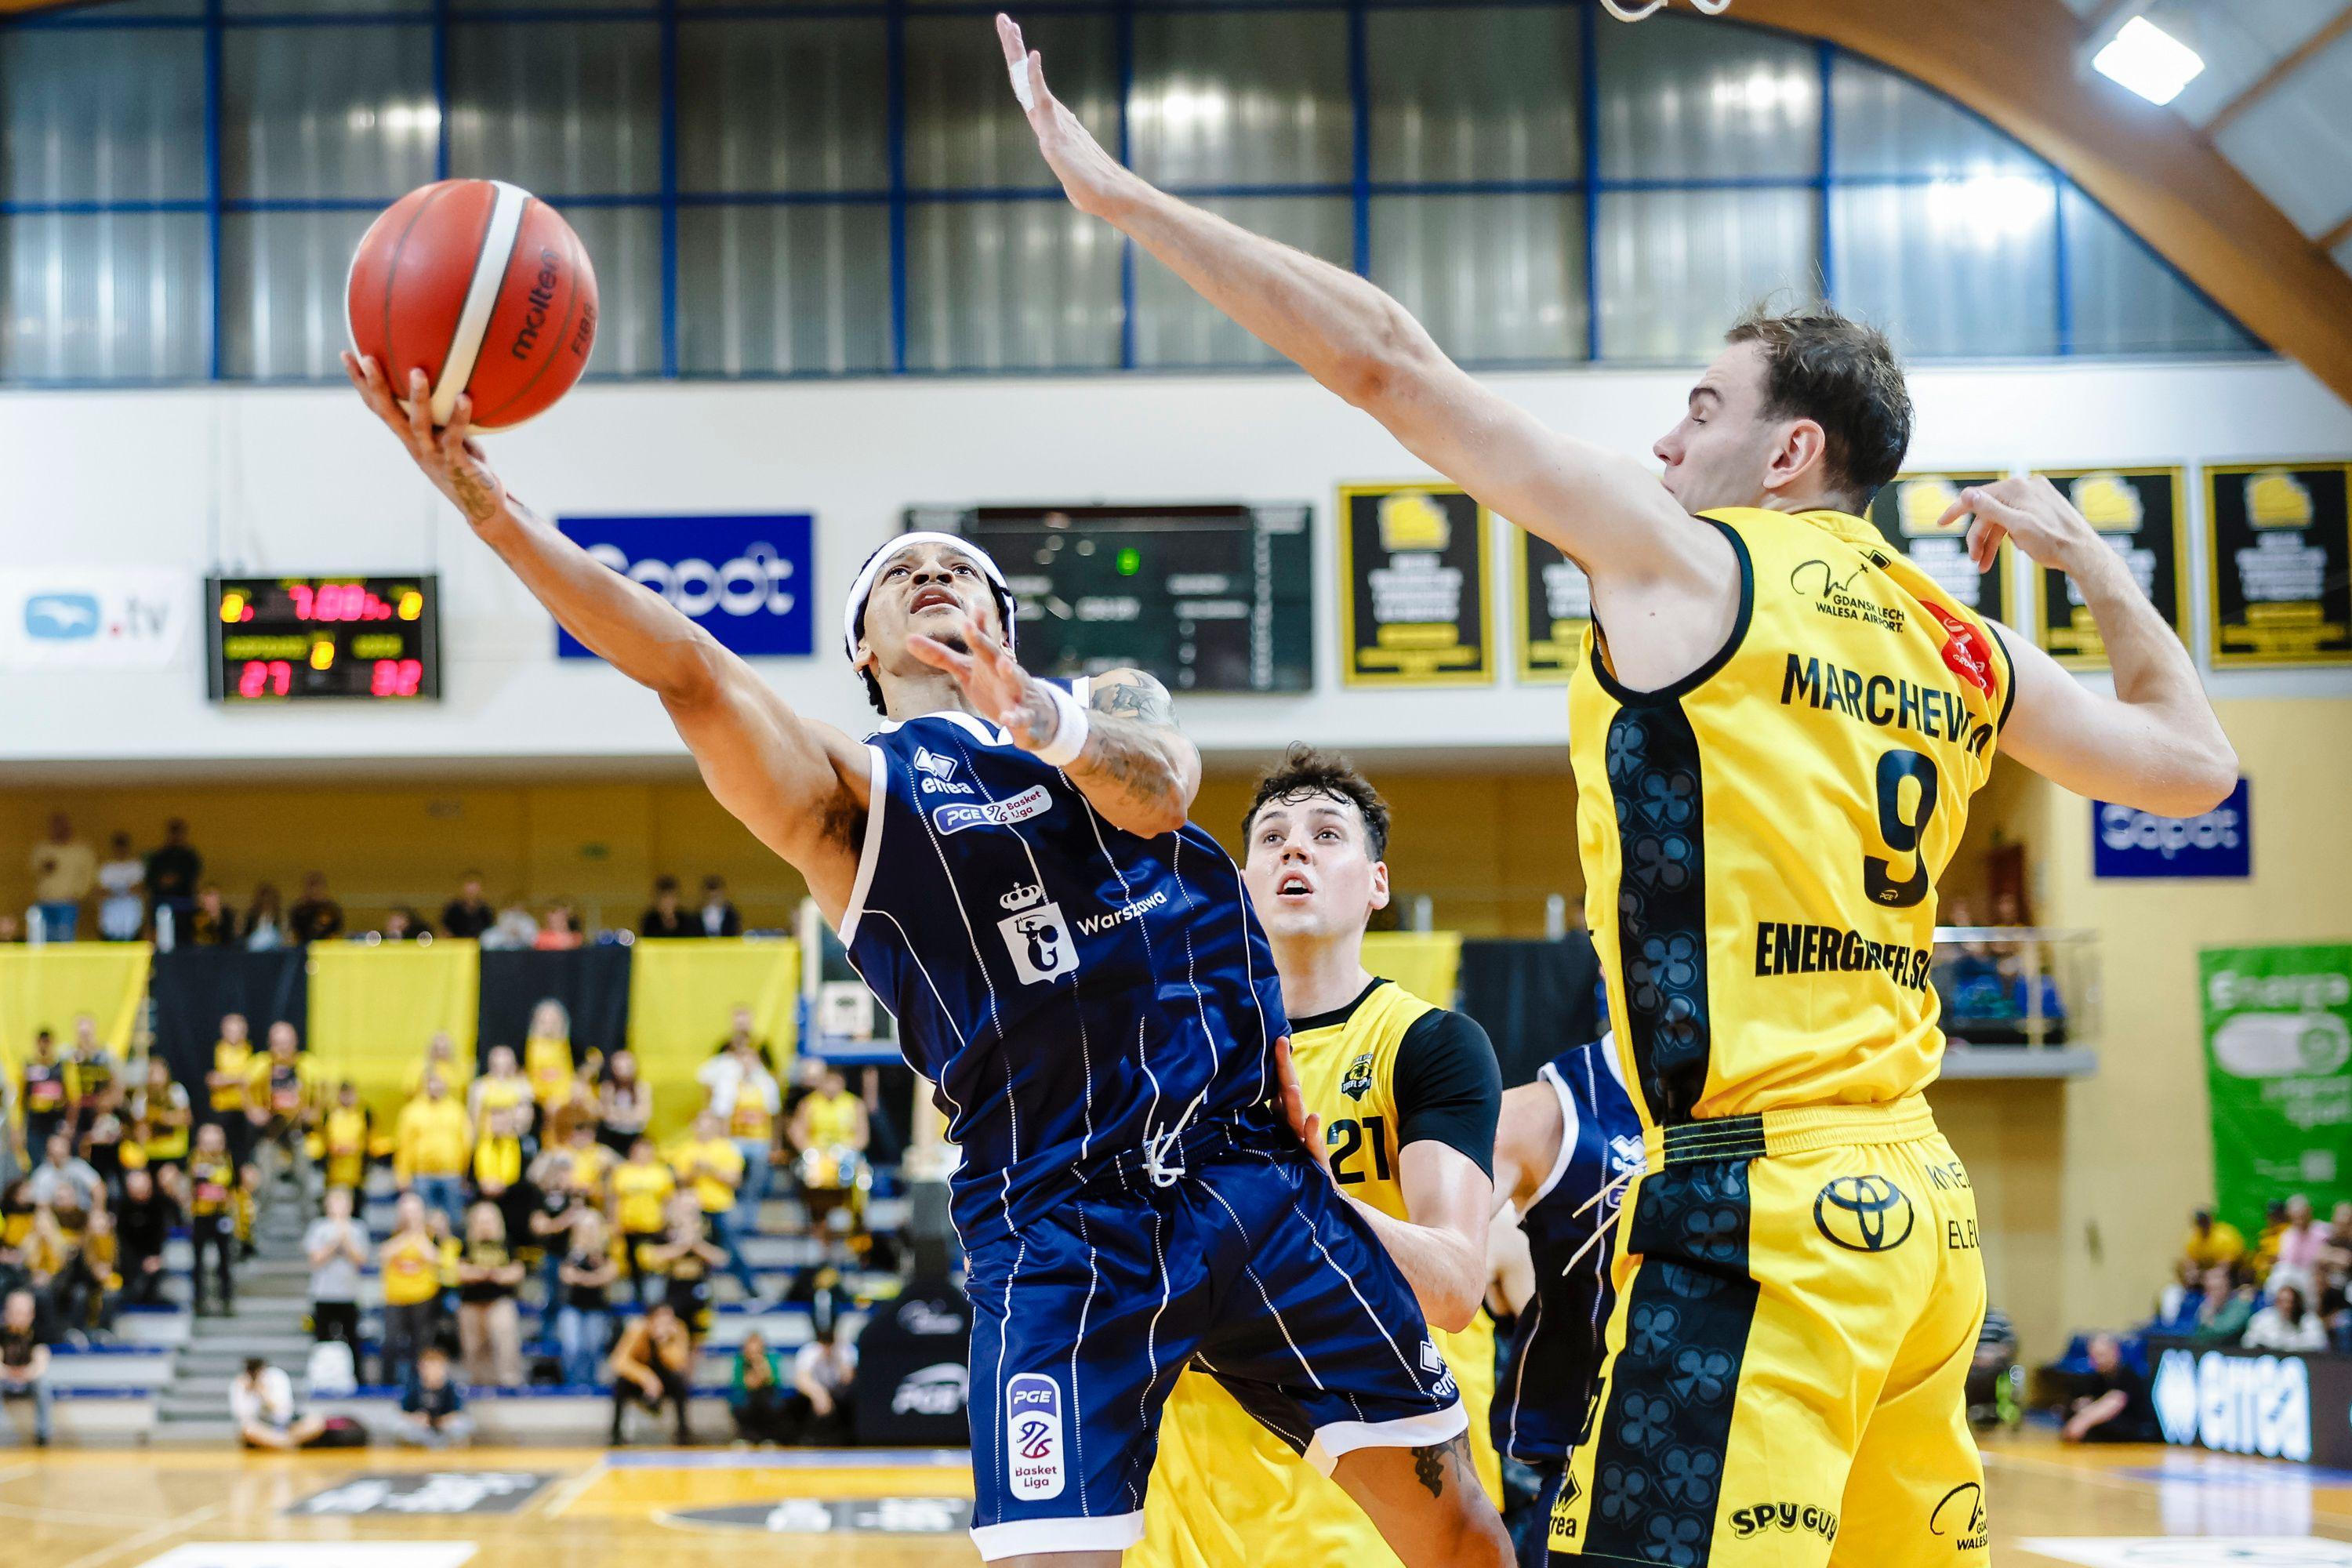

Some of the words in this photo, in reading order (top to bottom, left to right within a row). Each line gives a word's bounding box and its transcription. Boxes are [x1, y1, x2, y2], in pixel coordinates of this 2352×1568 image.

[512, 249, 560, 361] molten
[1815, 601, 1858, 620] WALESA
[1833, 594, 1876, 613] GDANSK
[1878, 606, 1905, 621] LECH
[1006, 790, 1042, 811] Basket
[946, 808, 982, 827] PGE
[1011, 805, 1034, 820] Liga
[1863, 749, 1938, 909] 9
[1076, 891, 1167, 937] Warszawa
[1327, 1116, 1391, 1185] 21
[1013, 1390, 1053, 1405] PGE
[1015, 1465, 1058, 1477] Basket
[1024, 1477, 1050, 1489] Liga
